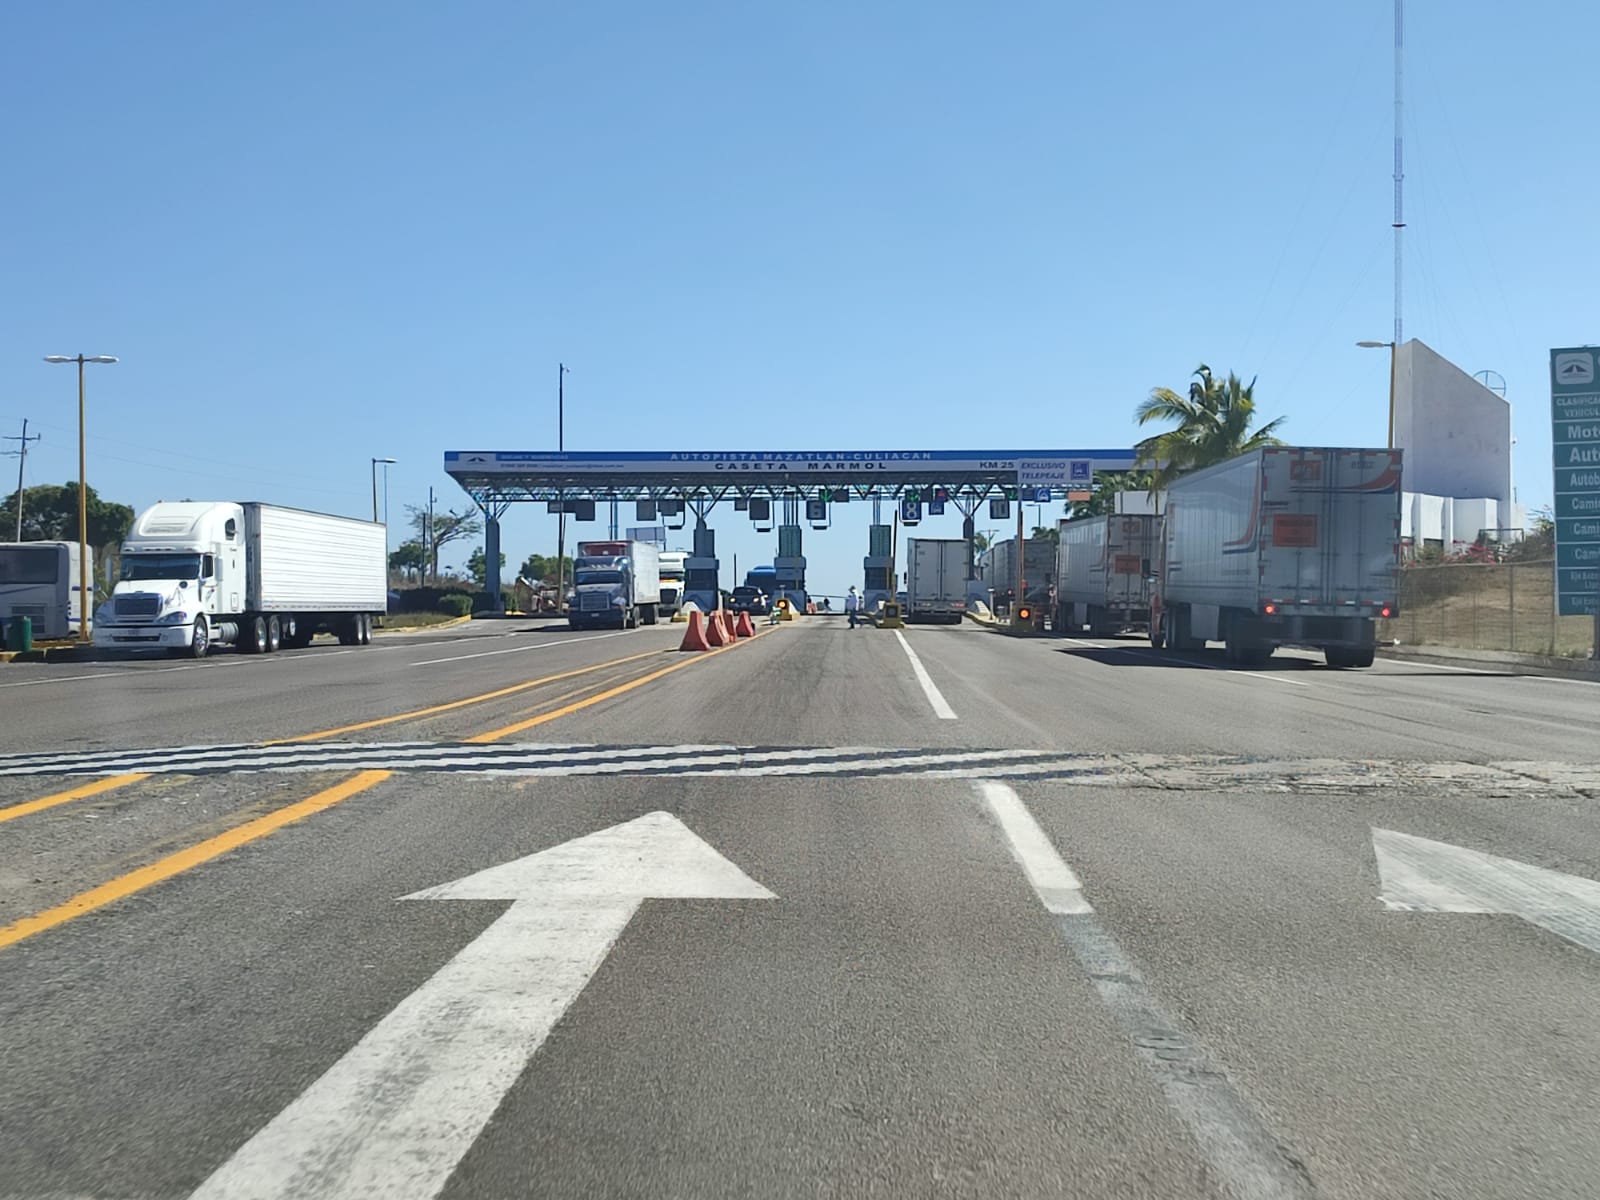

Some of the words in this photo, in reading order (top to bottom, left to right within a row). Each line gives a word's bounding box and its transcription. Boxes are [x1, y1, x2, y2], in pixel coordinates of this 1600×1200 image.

[1567, 424, 1600, 439] Mot
[670, 453, 758, 461] AUTOPISTA
[1569, 446, 1600, 463] Aut
[714, 462, 788, 471] CASETA
[807, 462, 887, 470] MARMOL
[979, 461, 998, 469] KM
[1000, 461, 1014, 469] 25
[1021, 461, 1066, 470] EXCLUSIVO
[1021, 472, 1065, 480] TELEPEAJE
[906, 502, 918, 519] 8
